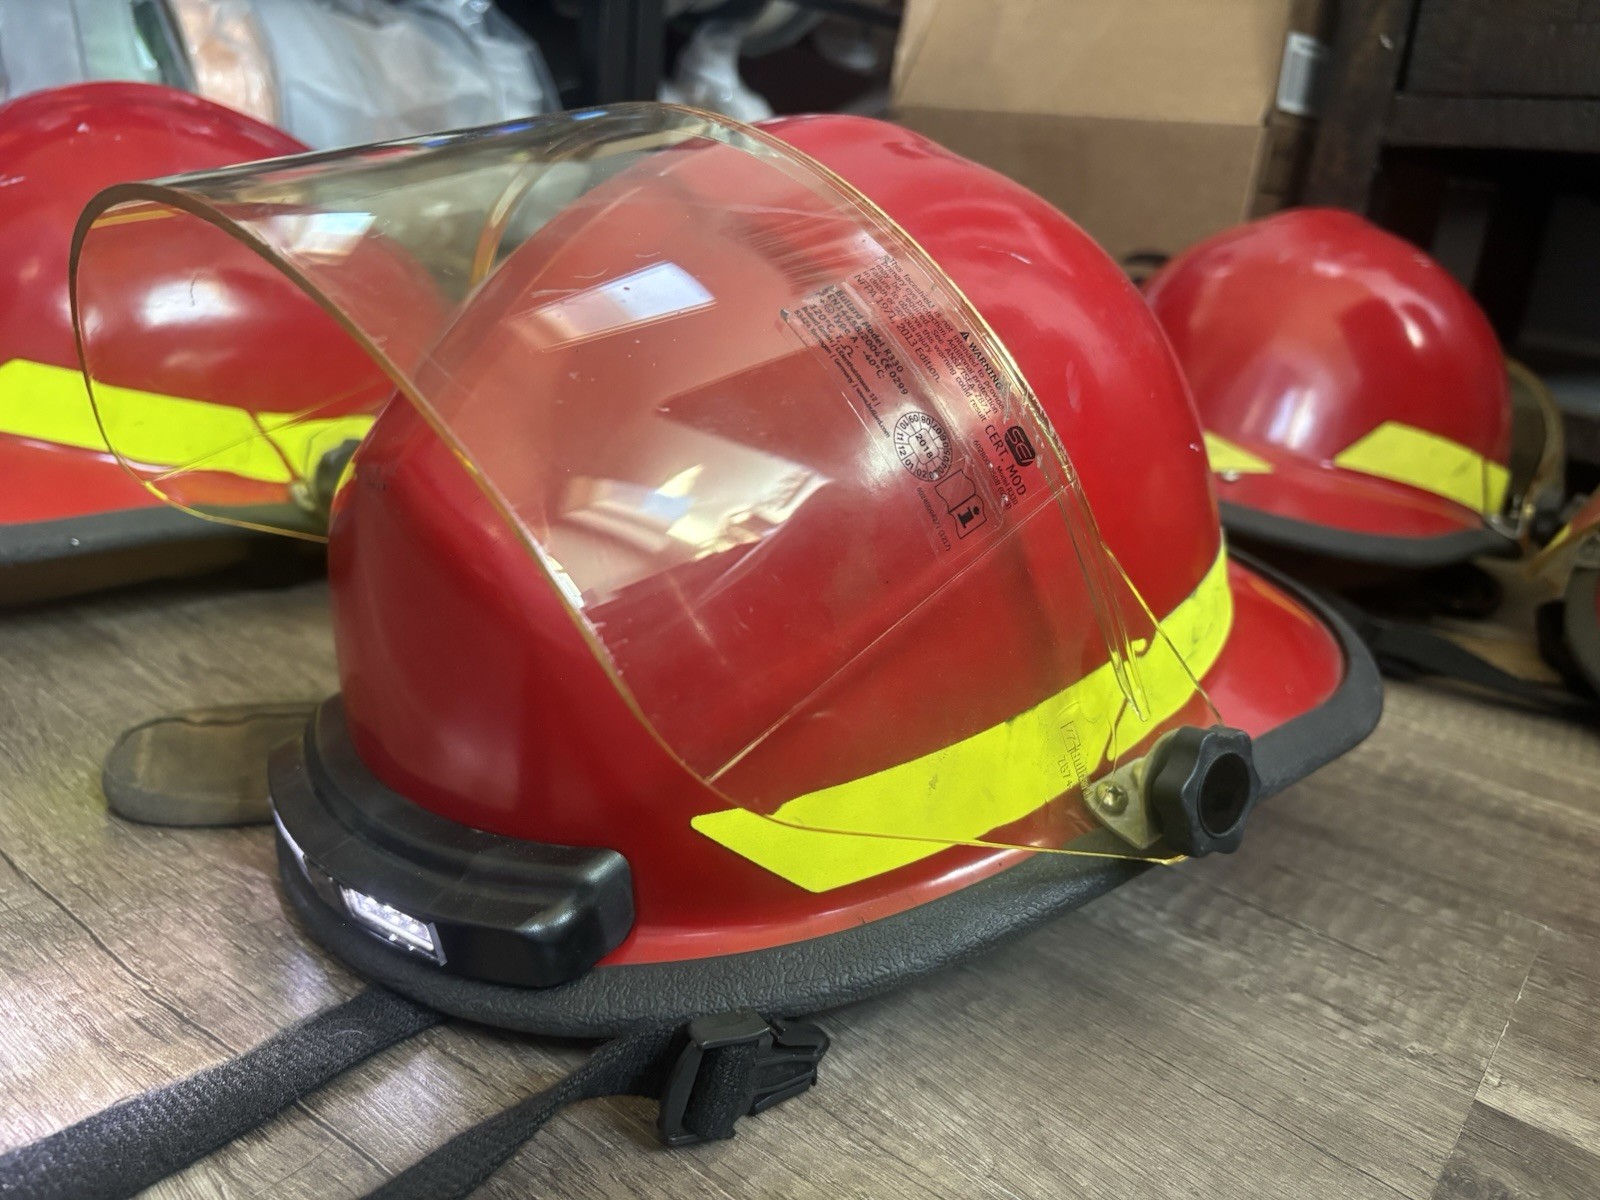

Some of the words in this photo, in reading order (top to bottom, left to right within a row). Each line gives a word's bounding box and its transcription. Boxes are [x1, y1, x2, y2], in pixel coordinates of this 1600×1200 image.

[834, 313, 851, 334] Type
[870, 278, 887, 297] death
[887, 297, 895, 305] or
[894, 306, 916, 332] serious
[915, 331, 933, 354] injury.
[890, 258, 903, 272] This
[904, 274, 935, 308] faceshield
[942, 320, 954, 332] not
[953, 335, 978, 368] intended
[978, 369, 985, 379] to
[835, 290, 863, 320] Bullard
[862, 321, 885, 347] Model
[883, 349, 904, 373] R330
[854, 274, 877, 298] NFPA
[876, 297, 896, 324] 1971,
[896, 323, 918, 347] 2013
[915, 347, 940, 383] Edition.
[881, 262, 907, 286] primary
[906, 288, 918, 300] eye
[916, 300, 946, 337] protection.
[947, 340, 974, 374] Additional
[973, 375, 998, 414] protection
[869, 267, 890, 290] Failure
[891, 291, 899, 299] to
[898, 300, 923, 328] observe
[923, 329, 934, 344] this
[934, 344, 957, 376] warning
[955, 377, 972, 398] could
[969, 398, 986, 422] result
[876, 265, 891, 278] may
[892, 281, 901, 291] be
[933, 329, 944, 344] See
[945, 348, 975, 390] ANSI/ISEA
[974, 393, 992, 418] Z87.1.
[889, 370, 909, 396] 0299
[900, 419, 909, 430] 10
[909, 414, 918, 423] 09
[921, 415, 931, 425] 08
[933, 424, 942, 435] 07
[897, 432, 904, 441] 11
[915, 433, 933, 458] 2018
[940, 434, 949, 448] 06
[898, 446, 907, 456] 12
[943, 450, 951, 462] 05
[985, 424, 1009, 462] CERT.
[1006, 464, 1027, 496] MOD
[905, 459, 914, 470] 01
[917, 468, 927, 478] 02
[996, 465, 1009, 487] Model
[1007, 487, 1019, 506] R330
